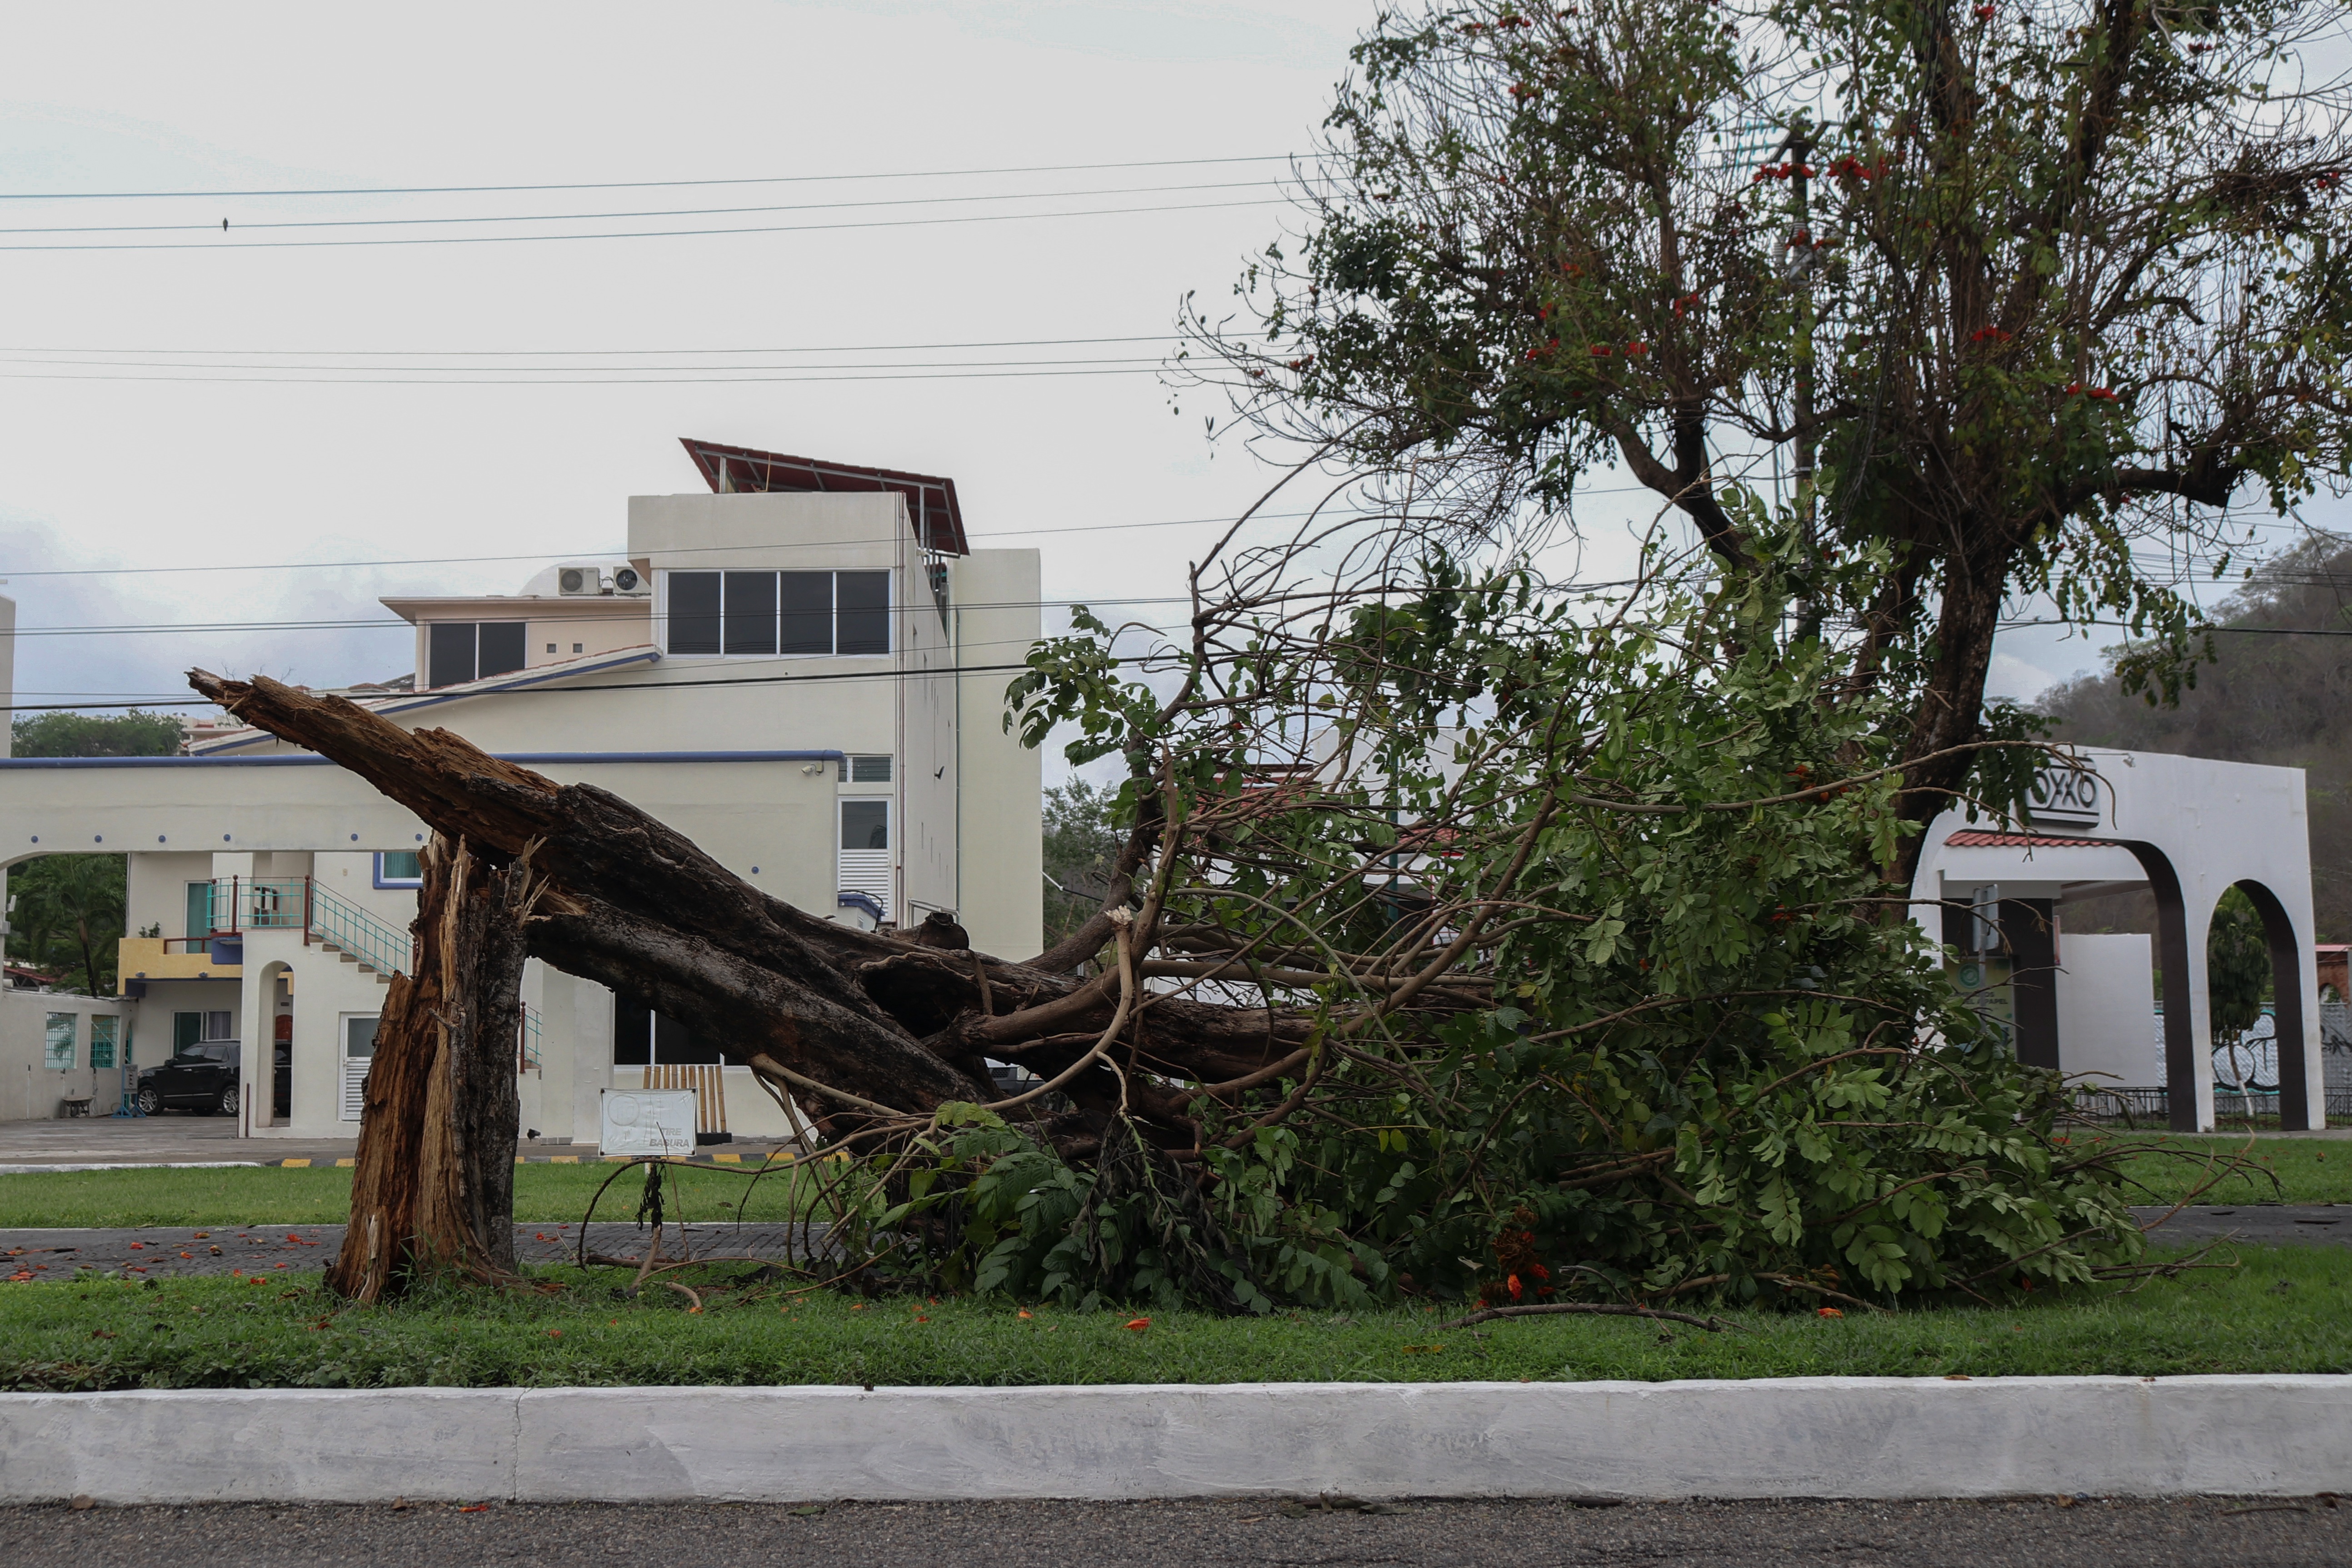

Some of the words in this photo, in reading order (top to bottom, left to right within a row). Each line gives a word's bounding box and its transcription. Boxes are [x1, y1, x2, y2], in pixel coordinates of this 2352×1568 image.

[2030, 770, 2097, 809] OXXO
[661, 1127, 682, 1136] TIRE
[649, 1139, 689, 1148] BASURA
